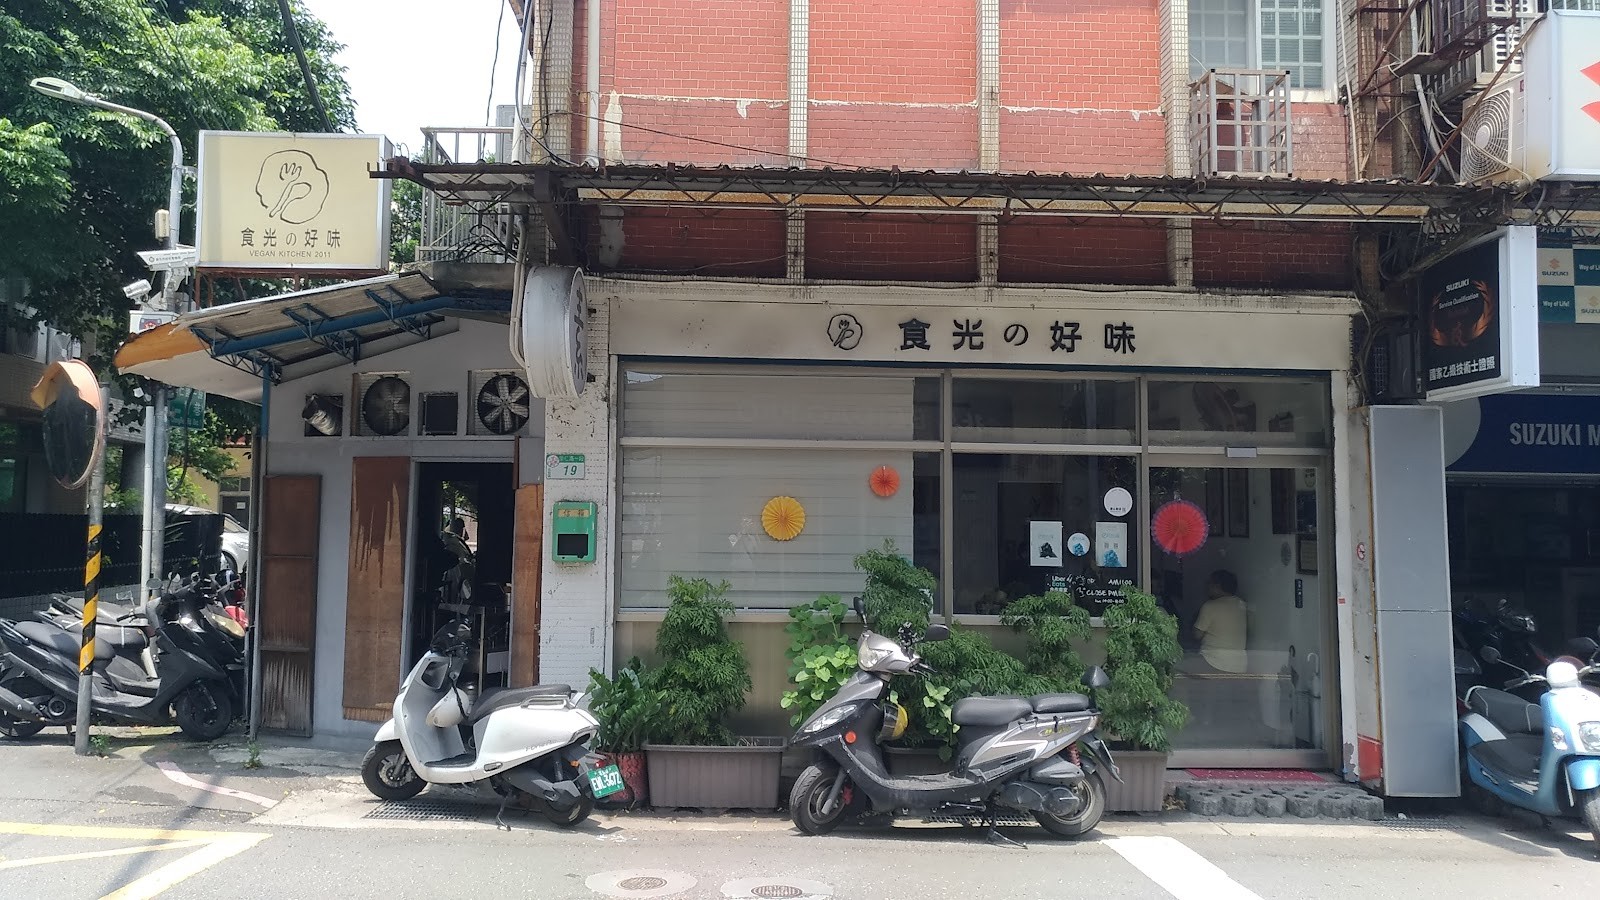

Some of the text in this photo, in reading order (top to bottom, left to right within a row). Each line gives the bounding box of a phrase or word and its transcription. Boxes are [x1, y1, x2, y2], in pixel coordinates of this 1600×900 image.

[240, 227, 341, 249] 食光の好味
[278, 250, 312, 258] KITCHEN
[1445, 278, 1470, 293] SUZUKI
[897, 317, 1138, 355] 食光の好味
[1429, 355, 1496, 382] 國家乙級技術士證照
[1509, 422, 1581, 446] SUZUKI
[563, 465, 578, 476] 19
